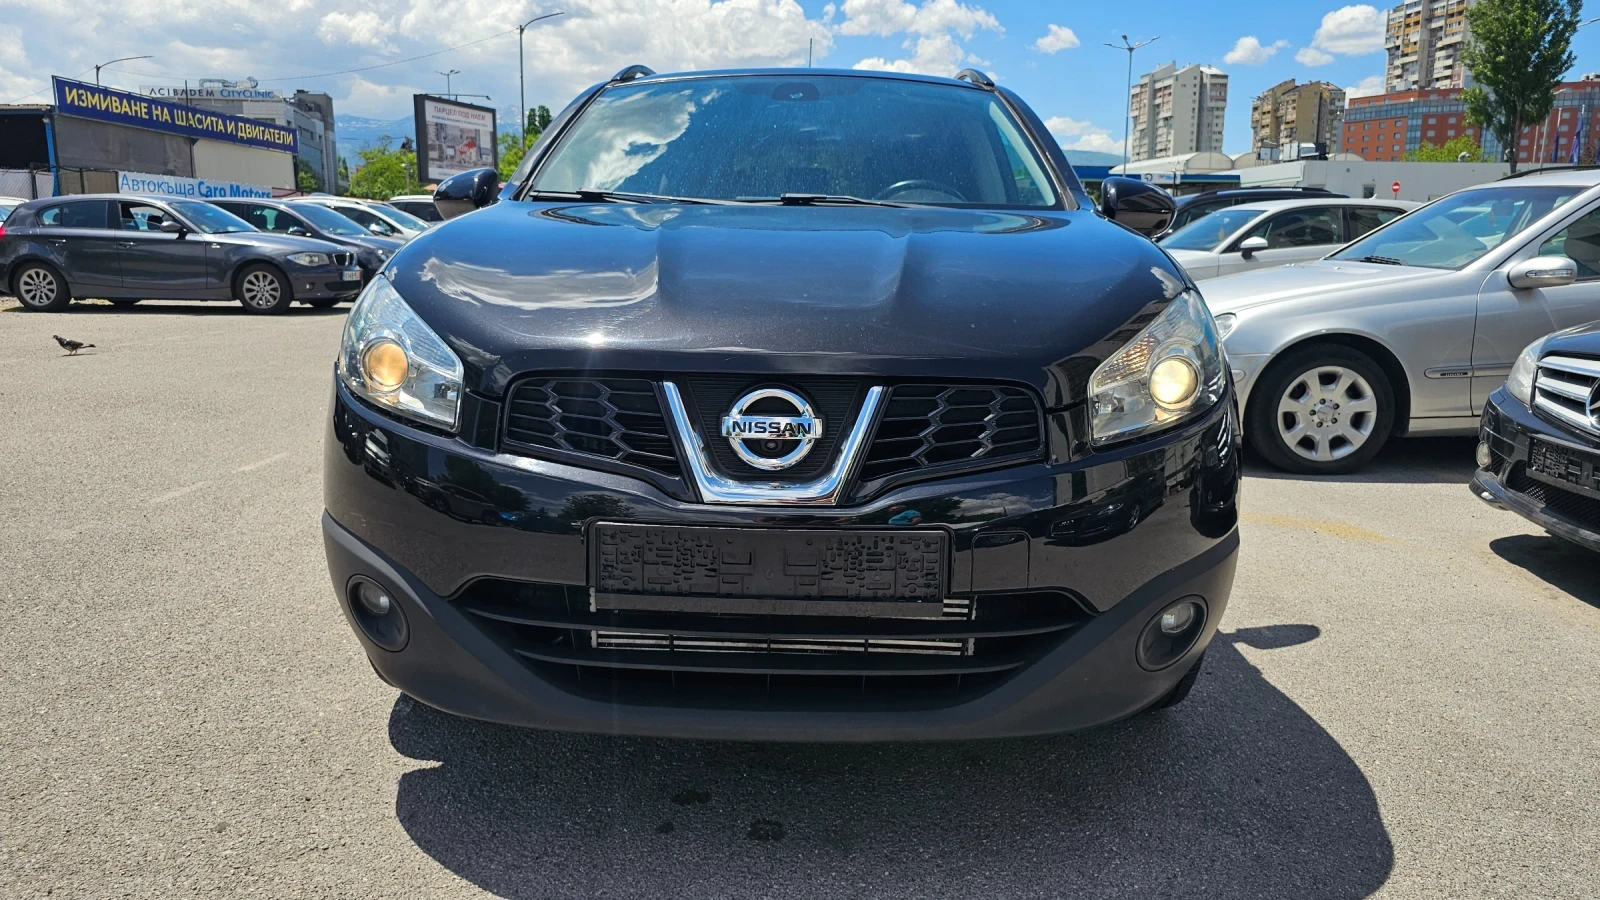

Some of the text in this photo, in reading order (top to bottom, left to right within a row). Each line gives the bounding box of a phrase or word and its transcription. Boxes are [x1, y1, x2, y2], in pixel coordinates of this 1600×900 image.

[149, 87, 215, 97] ACIBADEM
[65, 86, 294, 146] ИЗМИВАНЕ НА ШАСИТА И ДВИГАТЕЛИ
[120, 173, 272, 198] Автокъща Caro Motors
[732, 421, 812, 435] NISSAN
